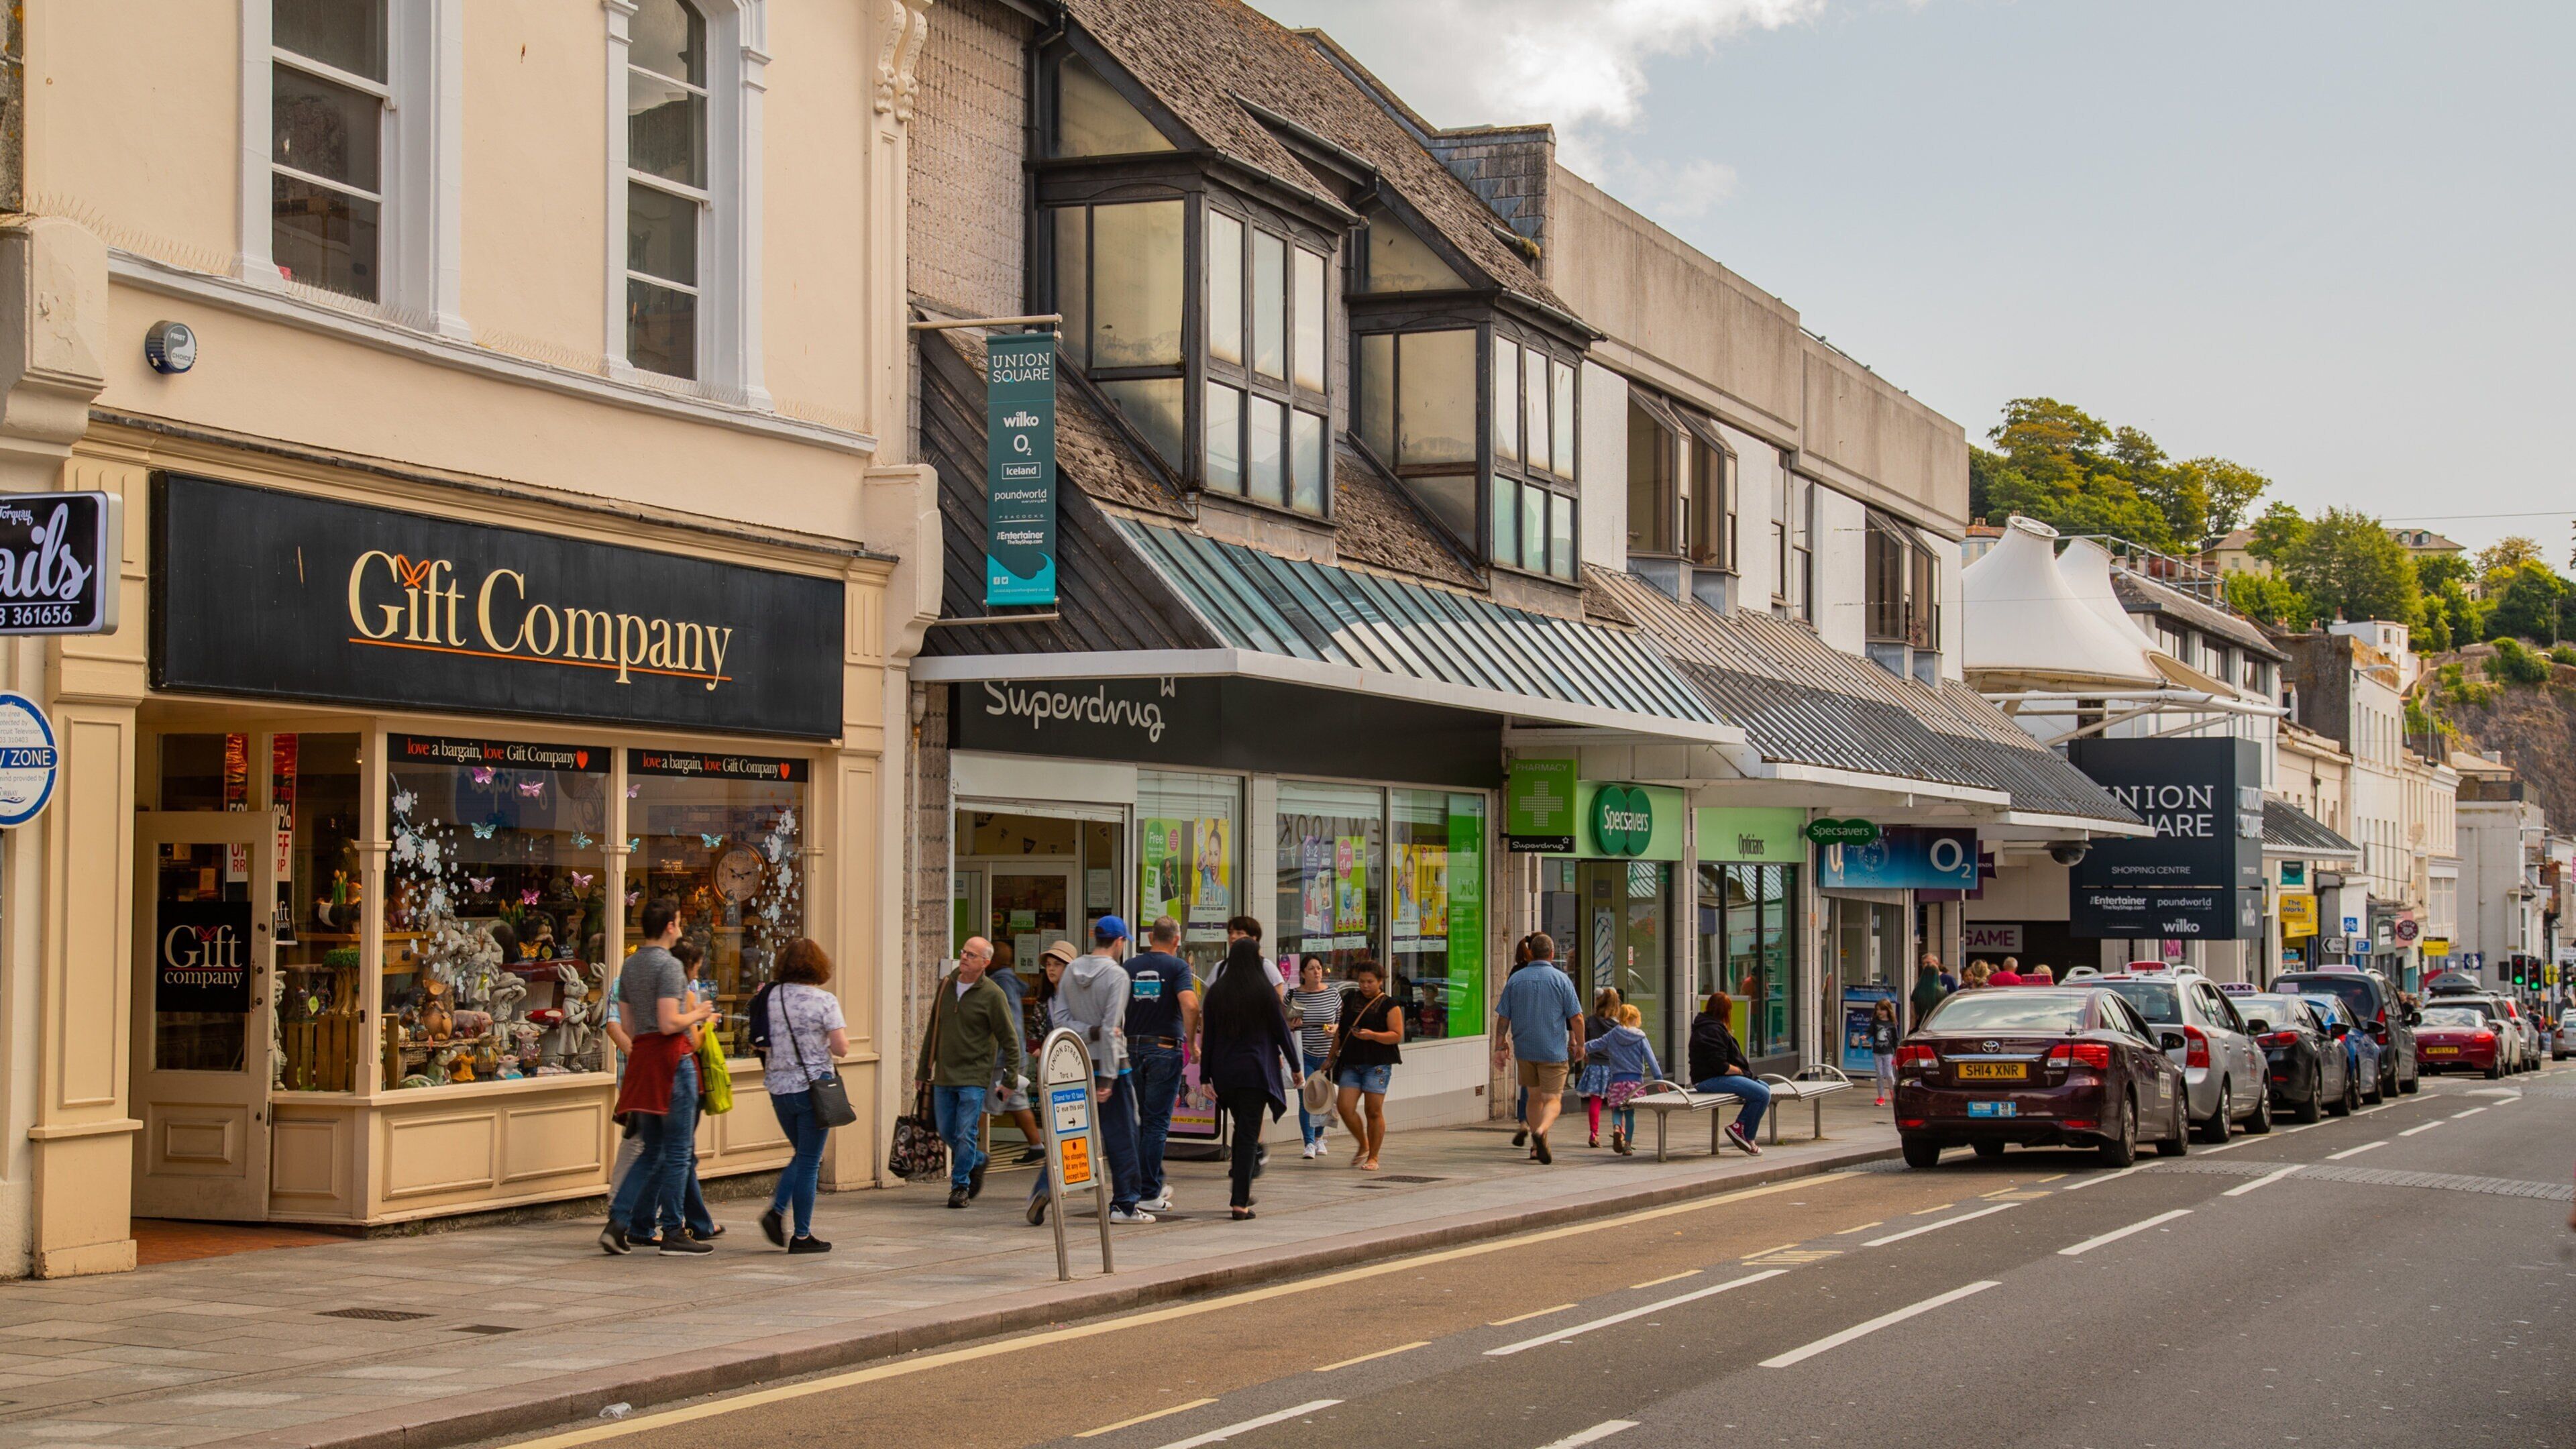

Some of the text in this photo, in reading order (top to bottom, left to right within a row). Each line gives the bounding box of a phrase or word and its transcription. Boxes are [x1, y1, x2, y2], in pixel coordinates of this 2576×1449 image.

[170, 332, 186, 341] FIRST
[172, 352, 191, 362] CHOICE
[992, 352, 1051, 368] UNION
[992, 367, 1051, 383] SQUARE
[1003, 411, 1039, 428] wilko
[1013, 434, 1032, 456] O2
[1006, 466, 1036, 476] Iceland
[994, 488, 1047, 502] poundworld
[1000, 529, 1044, 540] Entertainer
[0, 502, 93, 600] ails
[13, 605, 72, 625] 361656
[348, 550, 733, 691] Gift Company
[983, 679, 1165, 743] Superdrug
[11, 749, 51, 766] ZONE
[407, 738, 576, 769] love a bargain, love Gift Company
[643, 752, 780, 778] love a bargain, love Gift Company
[1515, 763, 1568, 772] PHARMACY
[13, 775, 37, 783] provided
[2099, 784, 2214, 810] NION
[273, 804, 291, 828] 0%
[1604, 804, 1648, 836] Specsavers
[1813, 824, 1870, 839] Specsavers
[2149, 813, 2214, 838] ARE
[278, 834, 289, 857] FF
[1148, 831, 1164, 844] Free
[1512, 841, 1565, 851] Superdrug
[1737, 833, 1765, 859] Opticians
[1305, 845, 1310, 857] 3
[1313, 845, 1318, 857] 2
[1930, 838, 1972, 879] O2
[232, 859, 247, 873] RR
[278, 859, 286, 872] RP
[2111, 866, 2192, 875] SHOPPING CENTRE
[276, 900, 290, 921] ift
[2094, 896, 2147, 905] Entertainer
[2157, 897, 2212, 908] poundworld
[2162, 918, 2200, 932] wilko
[164, 924, 242, 968] Gift
[1966, 930, 2015, 947] GAME
[164, 971, 243, 988] company
[1050, 1044, 1081, 1071] UNION STREET
[1966, 1065, 2019, 1077] SH14 XNR
[1071, 1152, 1087, 1160] stopping
